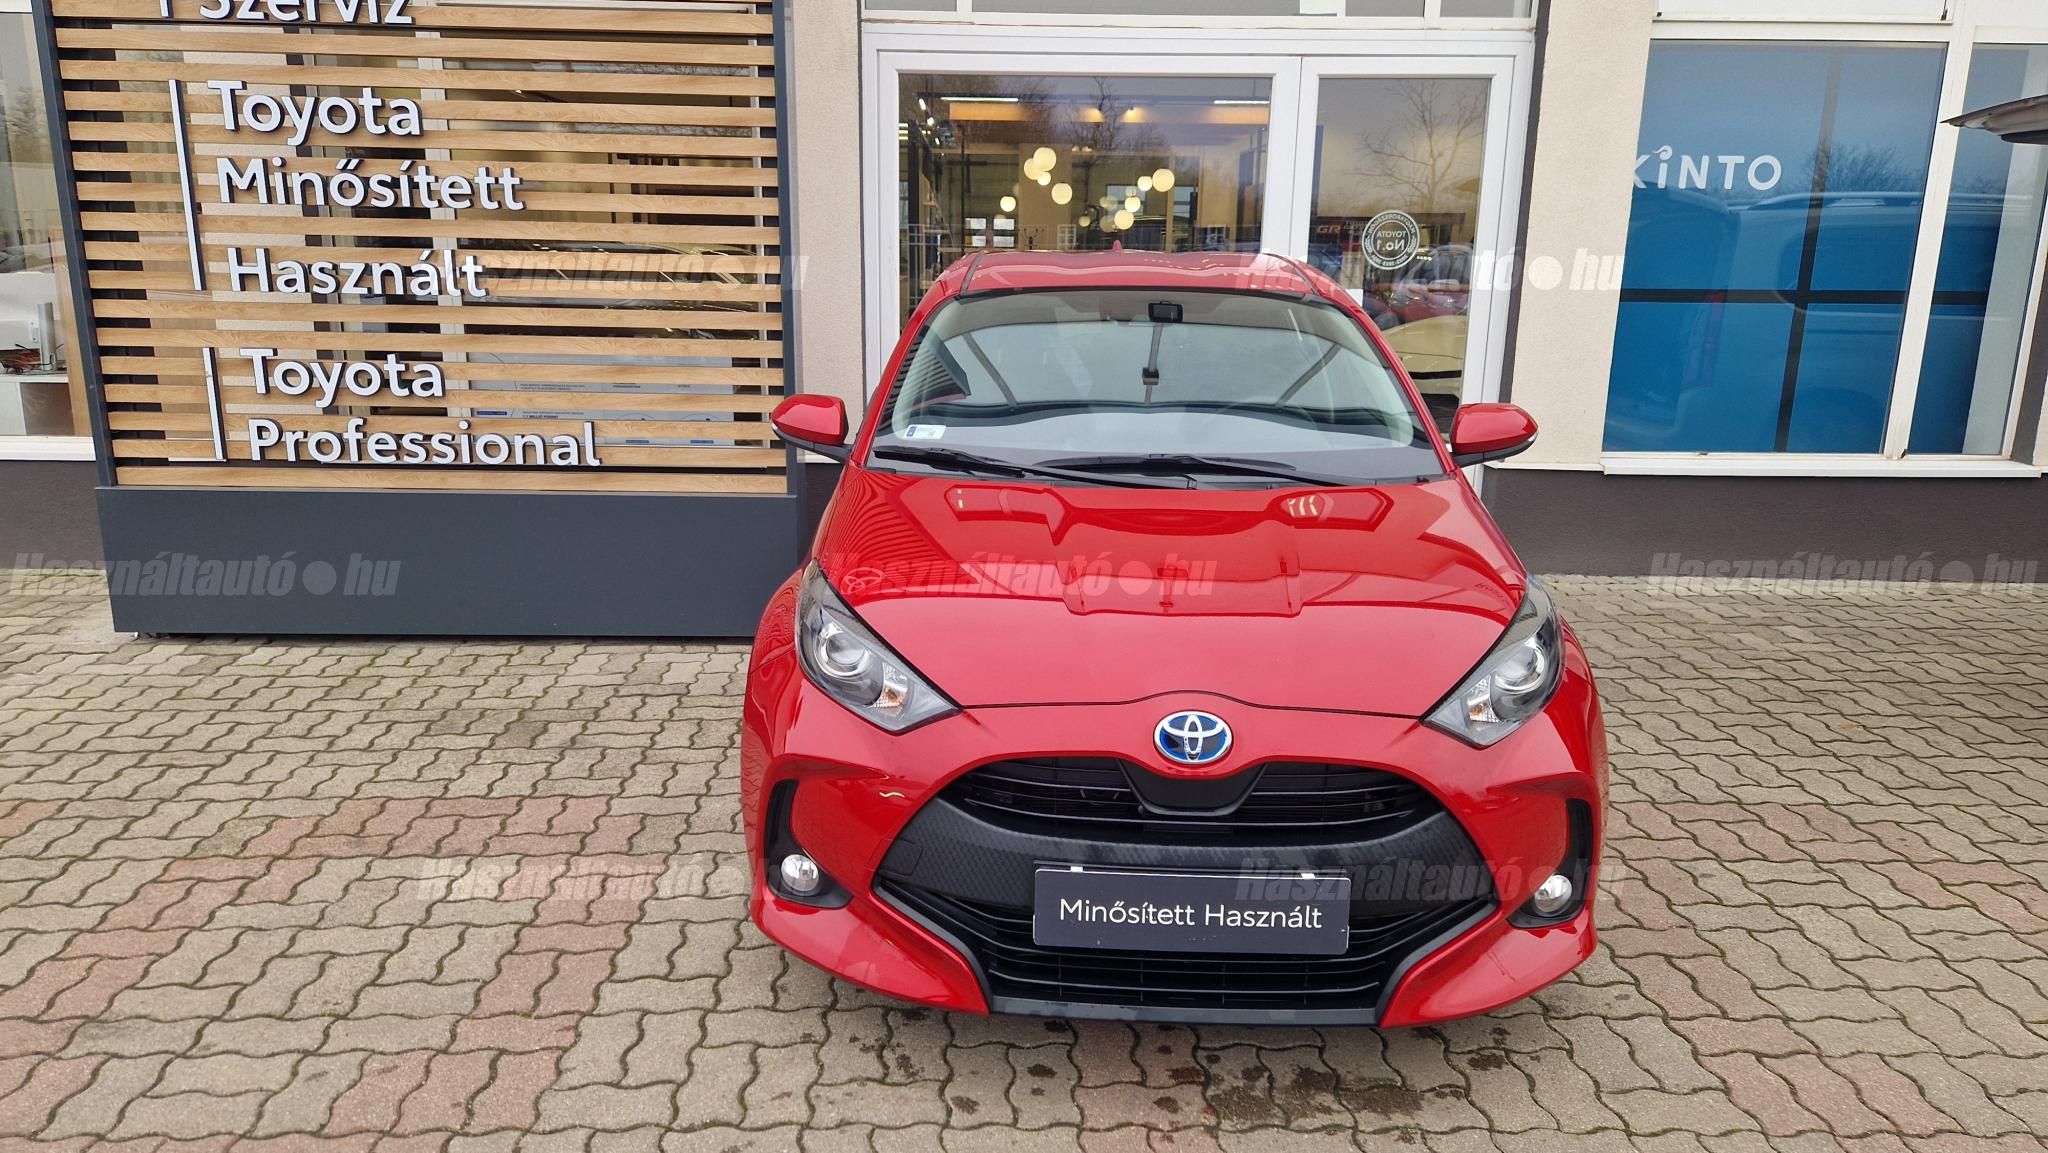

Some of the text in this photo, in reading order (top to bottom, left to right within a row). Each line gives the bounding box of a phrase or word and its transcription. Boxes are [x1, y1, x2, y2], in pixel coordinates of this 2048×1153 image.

[207, 80, 423, 146] Toyota
[216, 157, 525, 211] Minősített
[227, 247, 488, 297] Használt
[240, 348, 444, 408] Toyota
[249, 417, 601, 467] Professional
[1060, 898, 1323, 929] Minősített Használt
